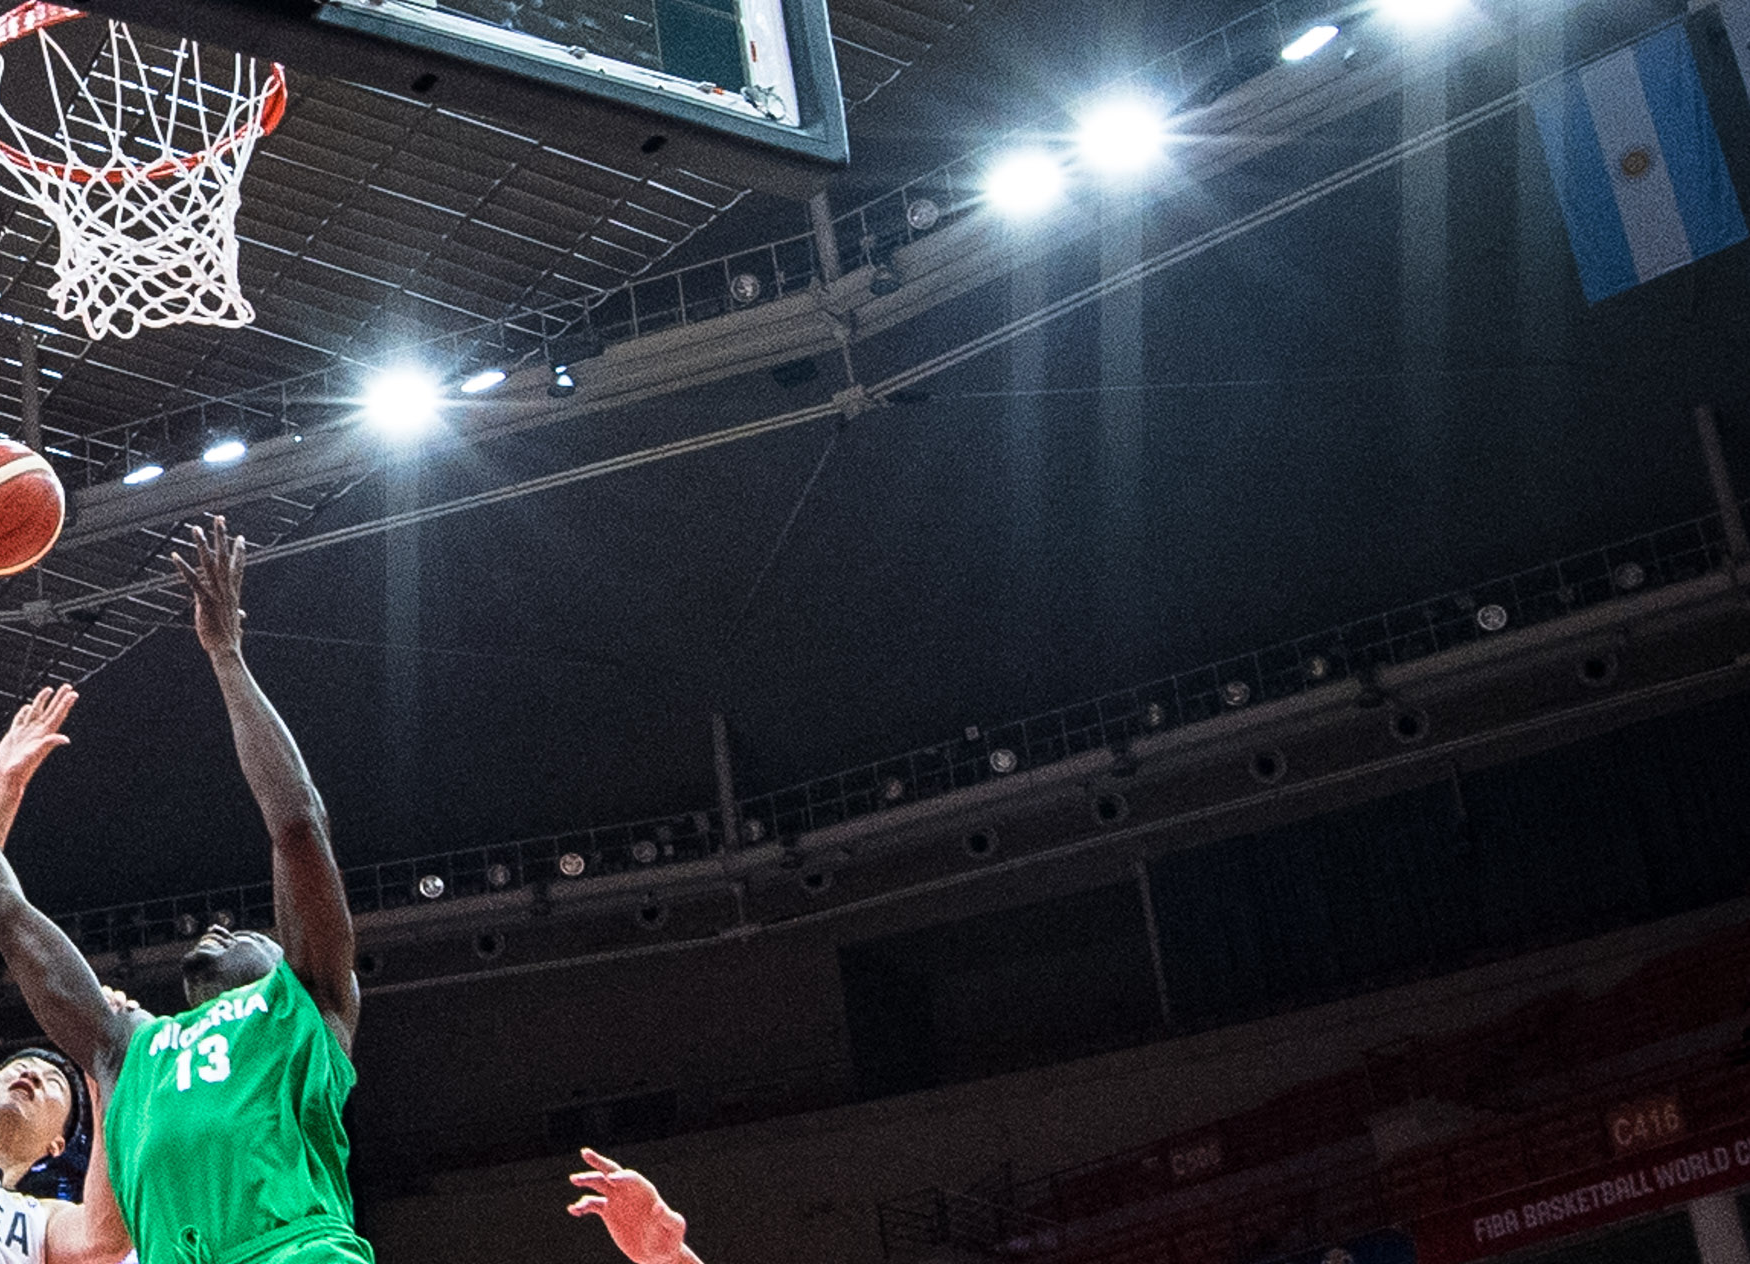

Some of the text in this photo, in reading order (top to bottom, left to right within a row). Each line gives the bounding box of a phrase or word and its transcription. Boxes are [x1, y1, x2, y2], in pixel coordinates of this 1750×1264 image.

[176, 1034, 231, 1092] 13
[1473, 1139, 1750, 1243] FIBA BASKETBALL WORLD C
